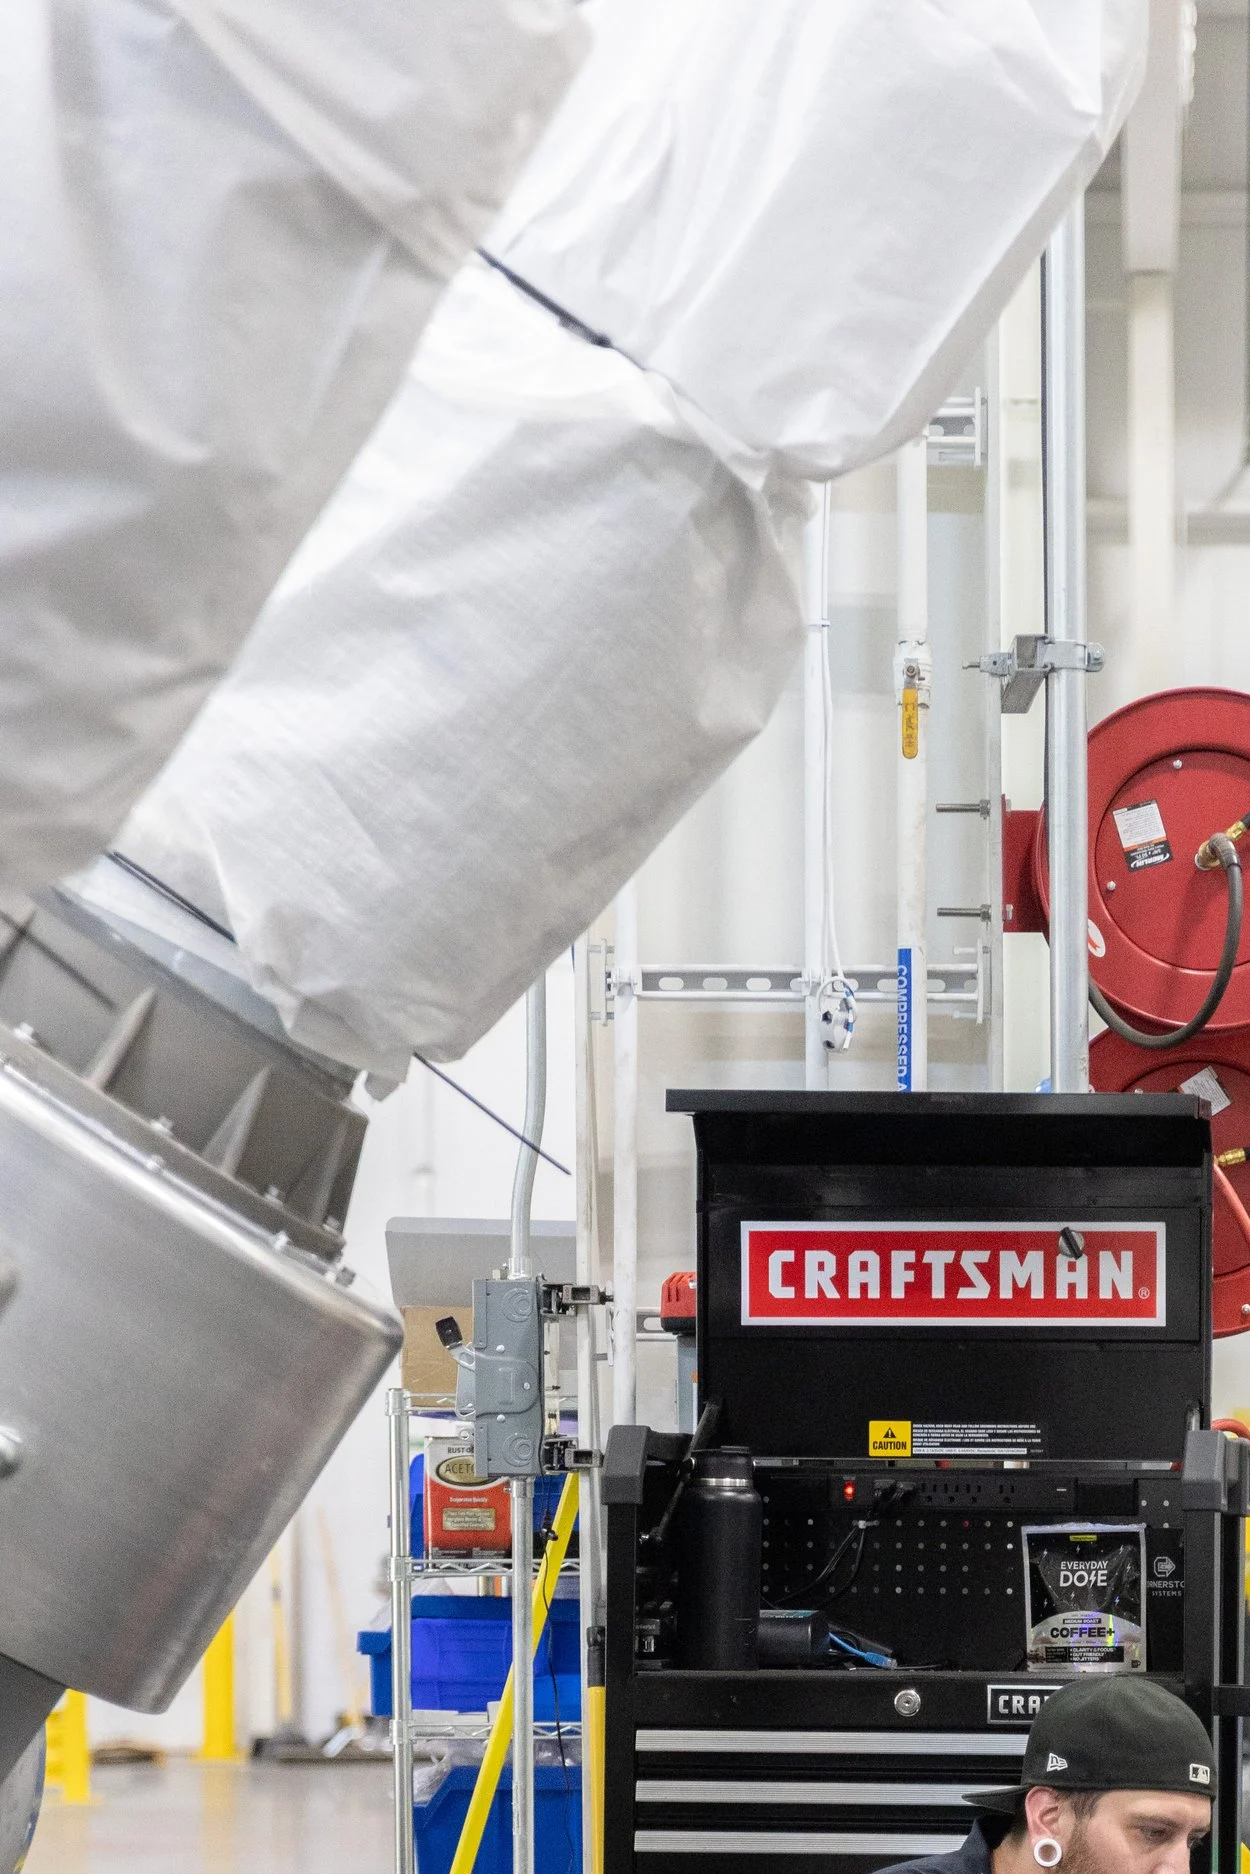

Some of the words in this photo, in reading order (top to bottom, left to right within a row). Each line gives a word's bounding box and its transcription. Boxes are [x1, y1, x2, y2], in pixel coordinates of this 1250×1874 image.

[872, 1440, 907, 1450] CAUTION
[1060, 1560, 1108, 1570] EVERYDAY
[1050, 1627, 1115, 1638] COFFEE+
